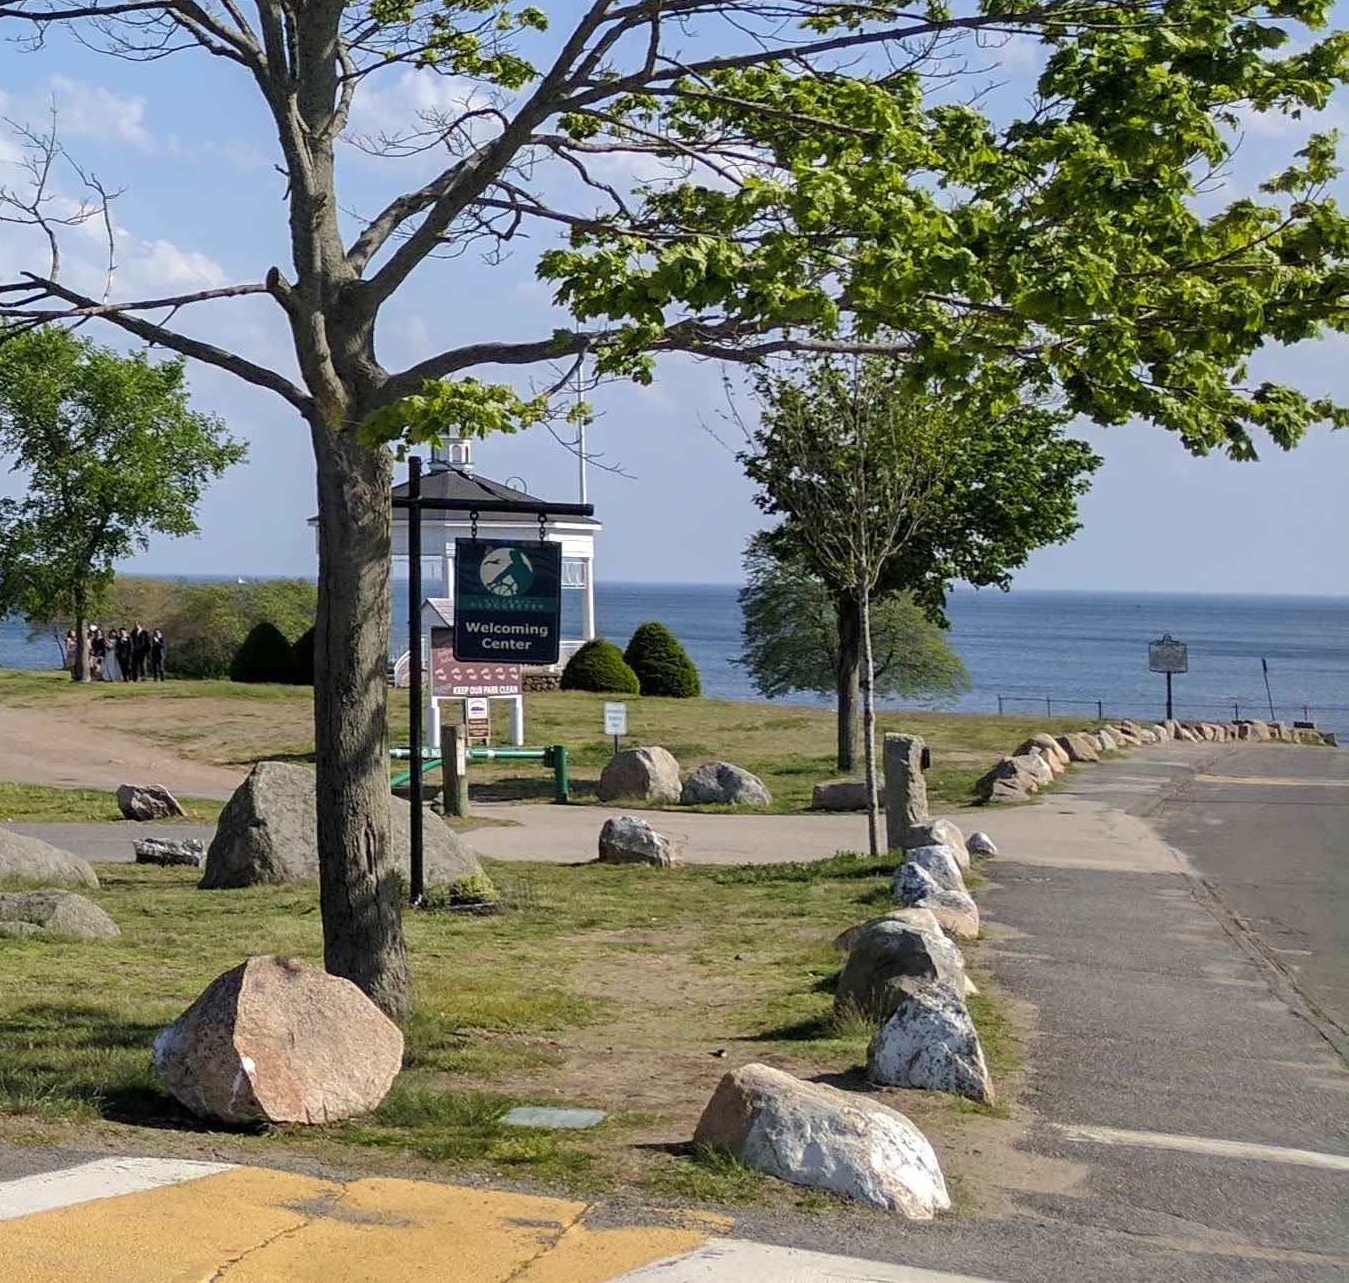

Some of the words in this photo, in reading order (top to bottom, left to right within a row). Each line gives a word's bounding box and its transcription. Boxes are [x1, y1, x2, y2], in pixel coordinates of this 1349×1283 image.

[465, 622, 549, 637] Welcoming
[482, 638, 532, 650] Center
[453, 686, 468, 694] KEEP
[469, 686, 482, 694] OUR
[483, 686, 498, 694] PARK
[499, 685, 518, 694] CLEAN
